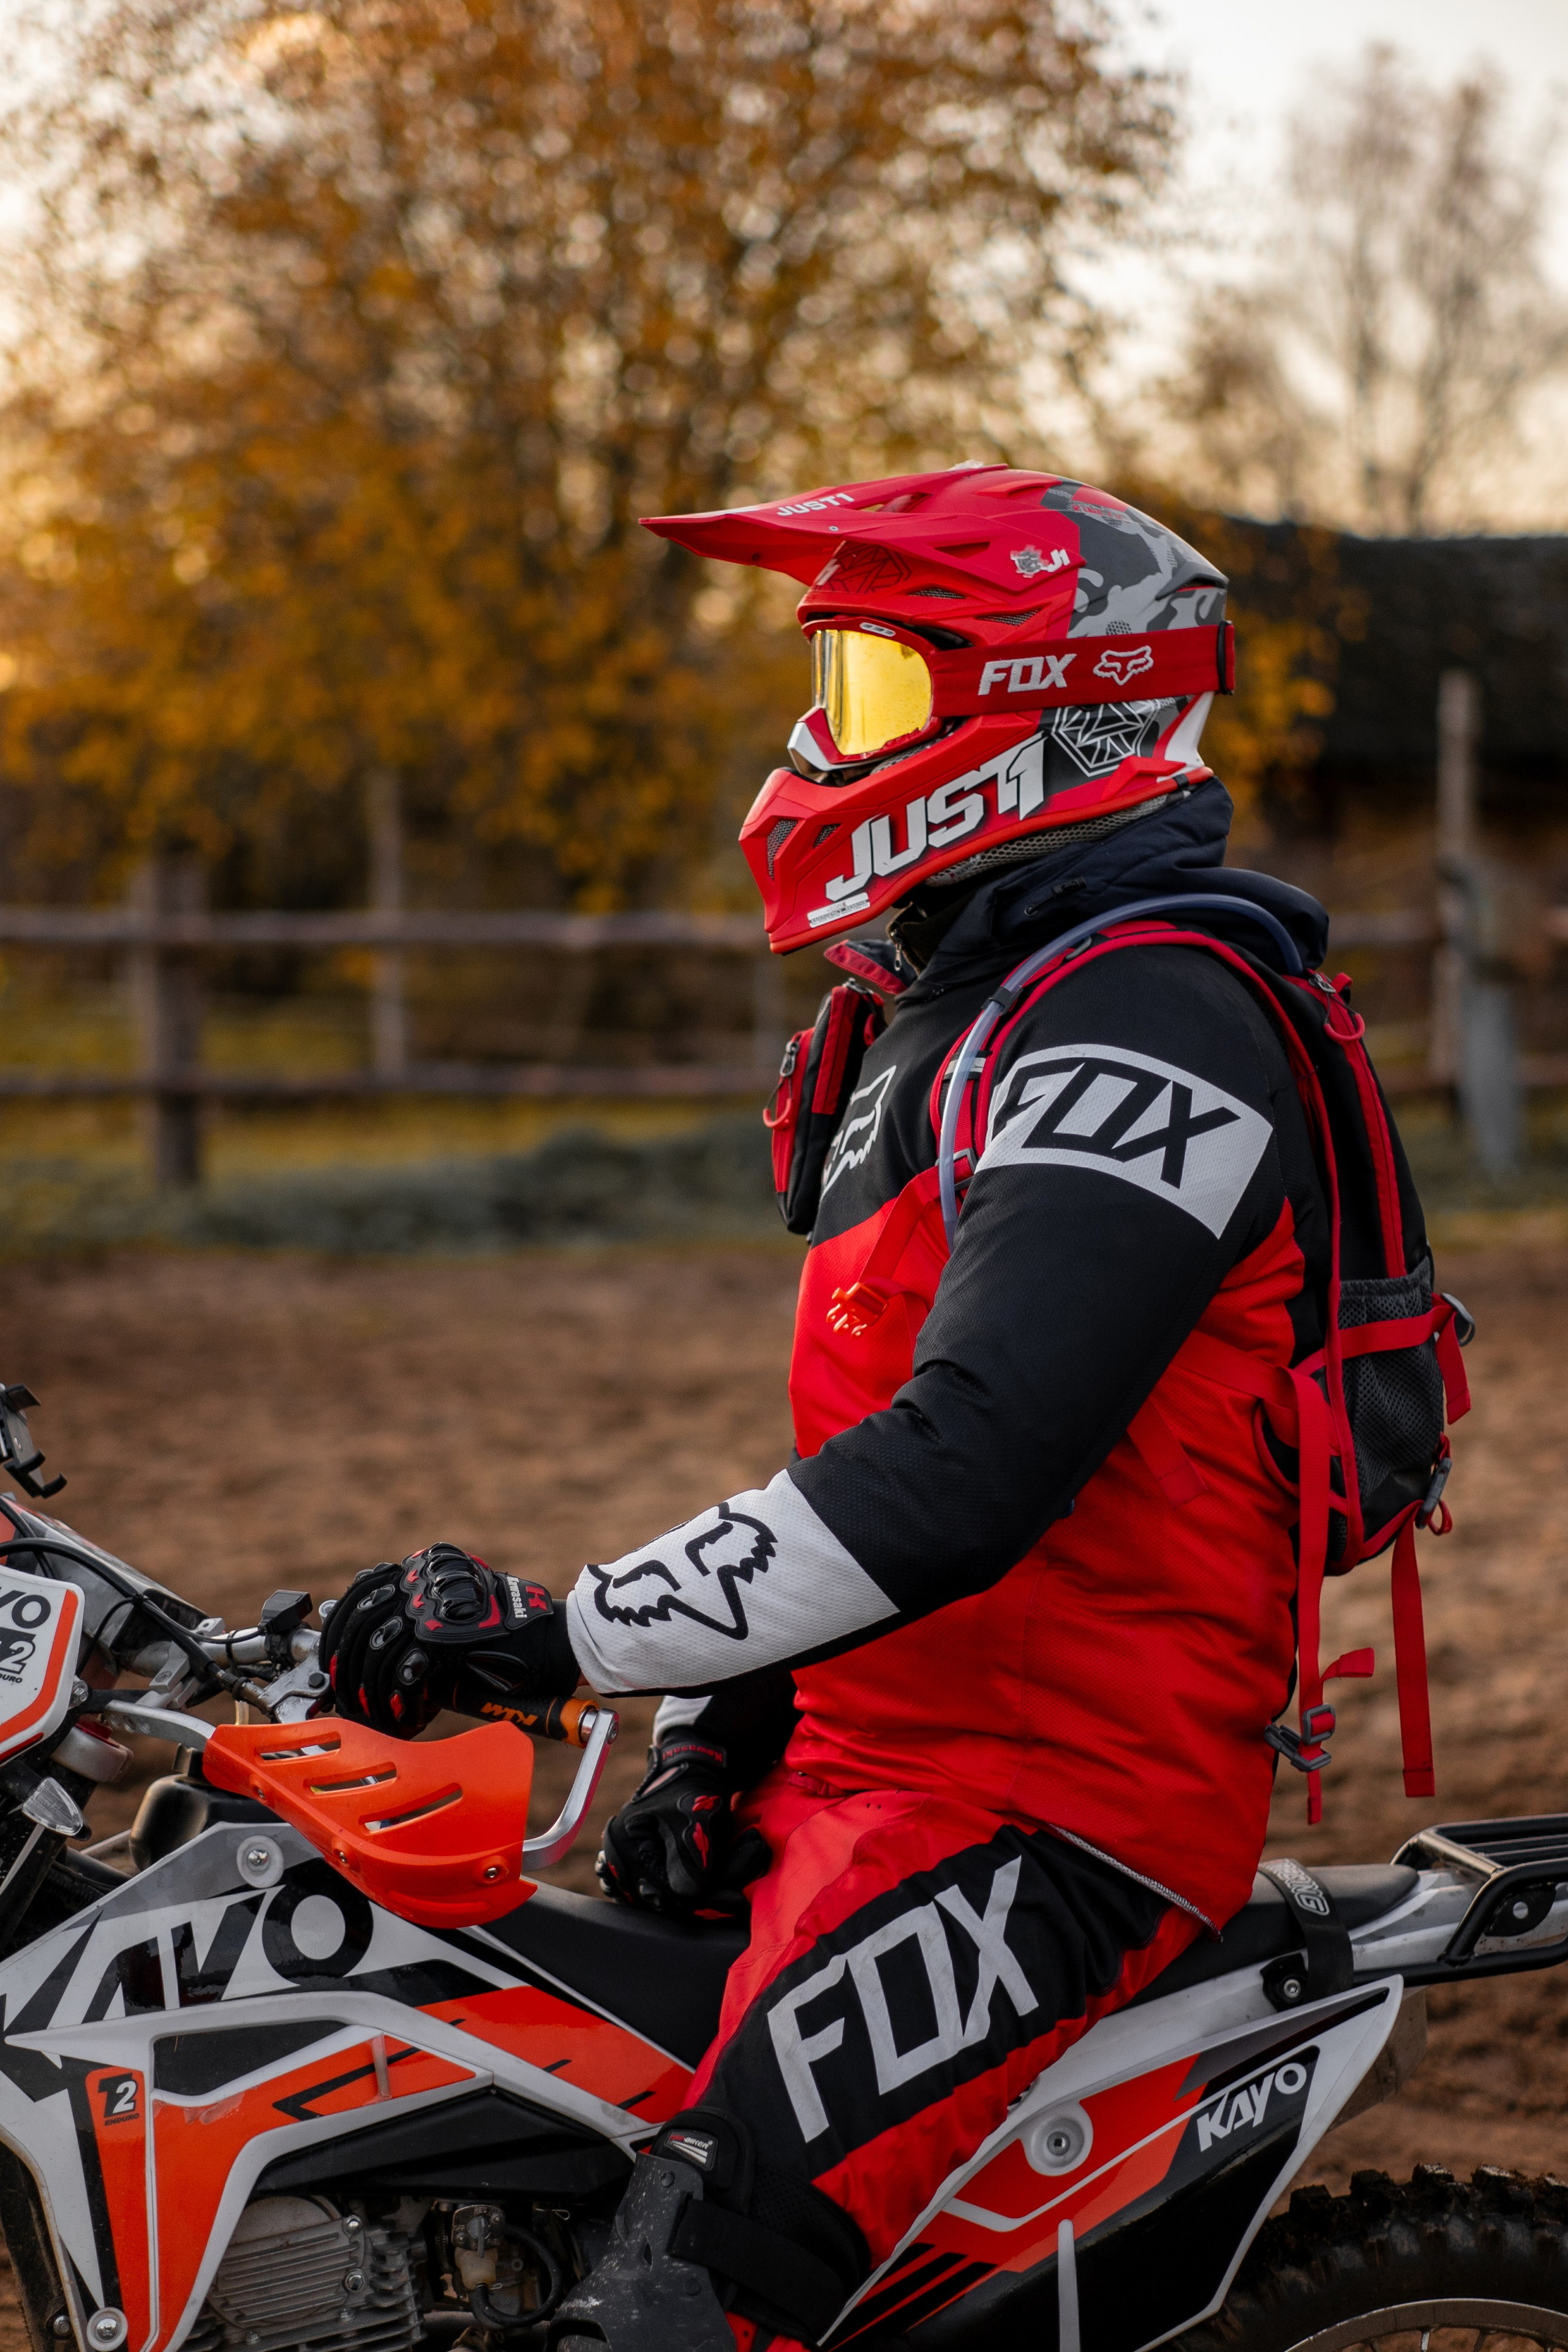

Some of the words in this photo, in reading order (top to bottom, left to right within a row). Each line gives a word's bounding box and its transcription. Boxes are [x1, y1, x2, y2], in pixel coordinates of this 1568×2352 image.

[777, 492, 855, 516] JUST1
[979, 653, 1076, 696] FOX
[825, 730, 1047, 902] JUST1
[993, 1056, 1242, 1189] FOX
[507, 1576, 527, 1618] Kawasaki
[480, 1702, 538, 1726] KTM
[767, 1855, 1039, 2143] FOX
[104, 2113, 140, 2126] ENDURO
[1197, 2062, 1307, 2152] KAYO
